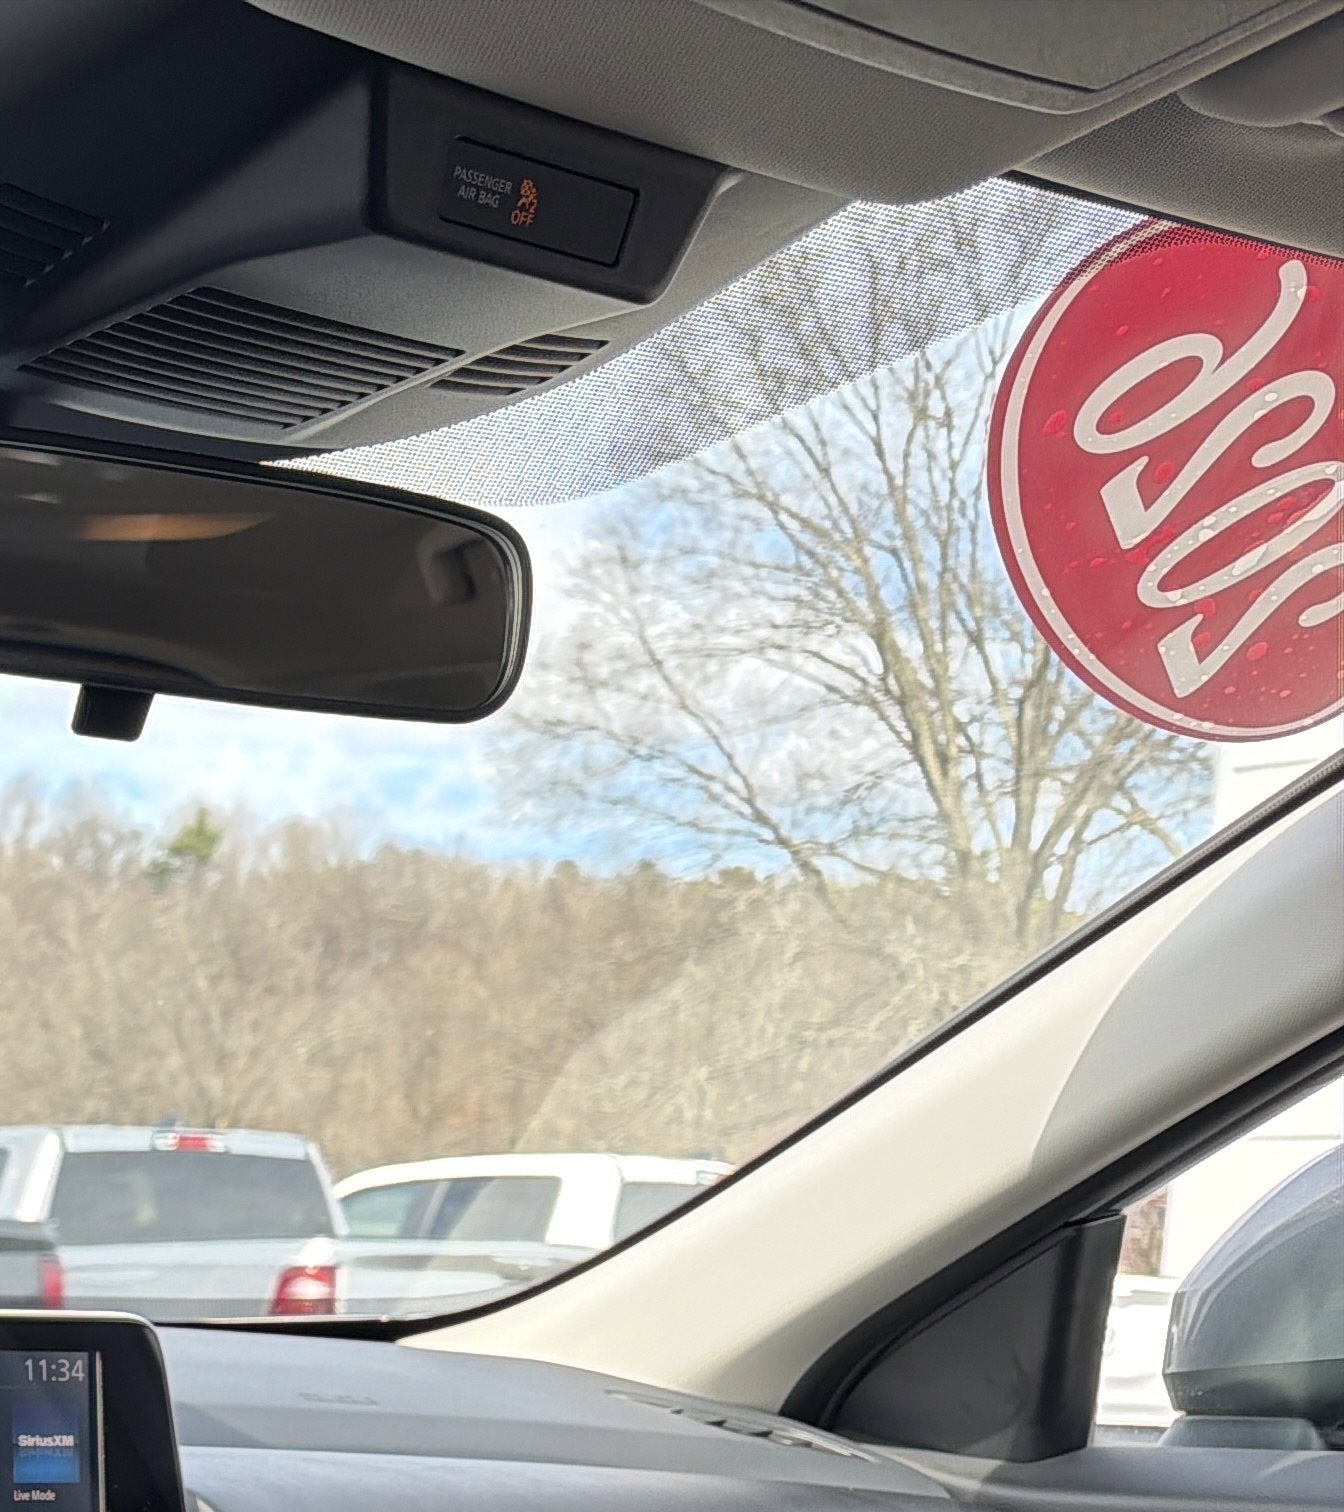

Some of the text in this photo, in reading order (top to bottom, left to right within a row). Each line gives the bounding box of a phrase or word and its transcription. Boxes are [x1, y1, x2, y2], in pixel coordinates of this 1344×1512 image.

[454, 166, 512, 194] PASSENGER
[457, 184, 500, 208] AIR BAG
[511, 210, 535, 227] OFF
[24, 1358, 85, 1382] 11:34
[13, 1489, 56, 1501] Live Mode
